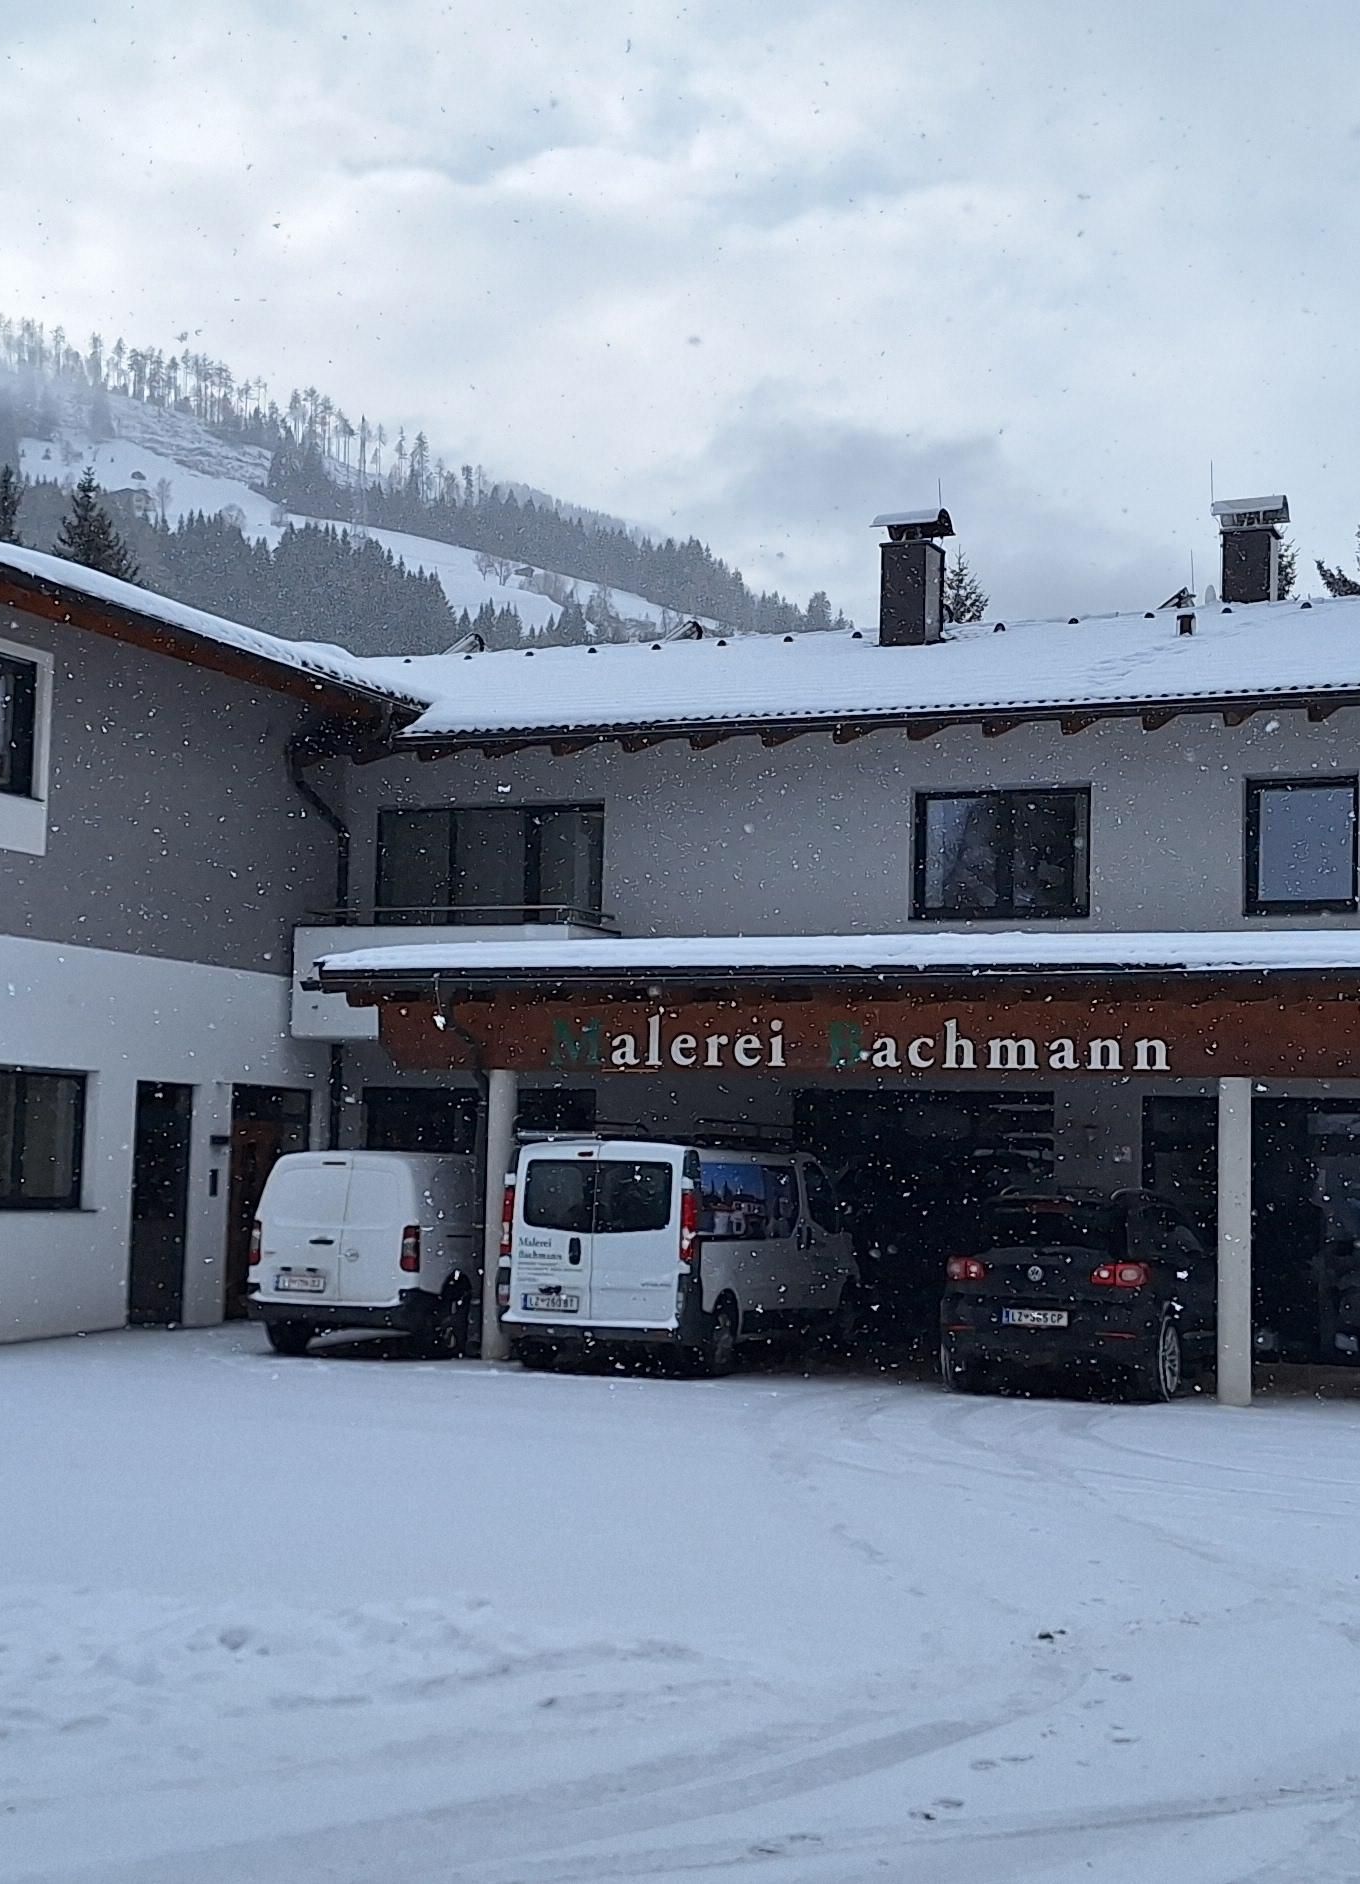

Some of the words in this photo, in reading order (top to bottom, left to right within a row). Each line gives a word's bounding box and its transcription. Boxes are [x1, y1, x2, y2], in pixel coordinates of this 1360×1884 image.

[551, 1013, 786, 1067] Malerei
[829, 1017, 1171, 1071] Bachmann
[518, 1236, 552, 1248] Malerei
[518, 1249, 563, 1261] Bachmann
